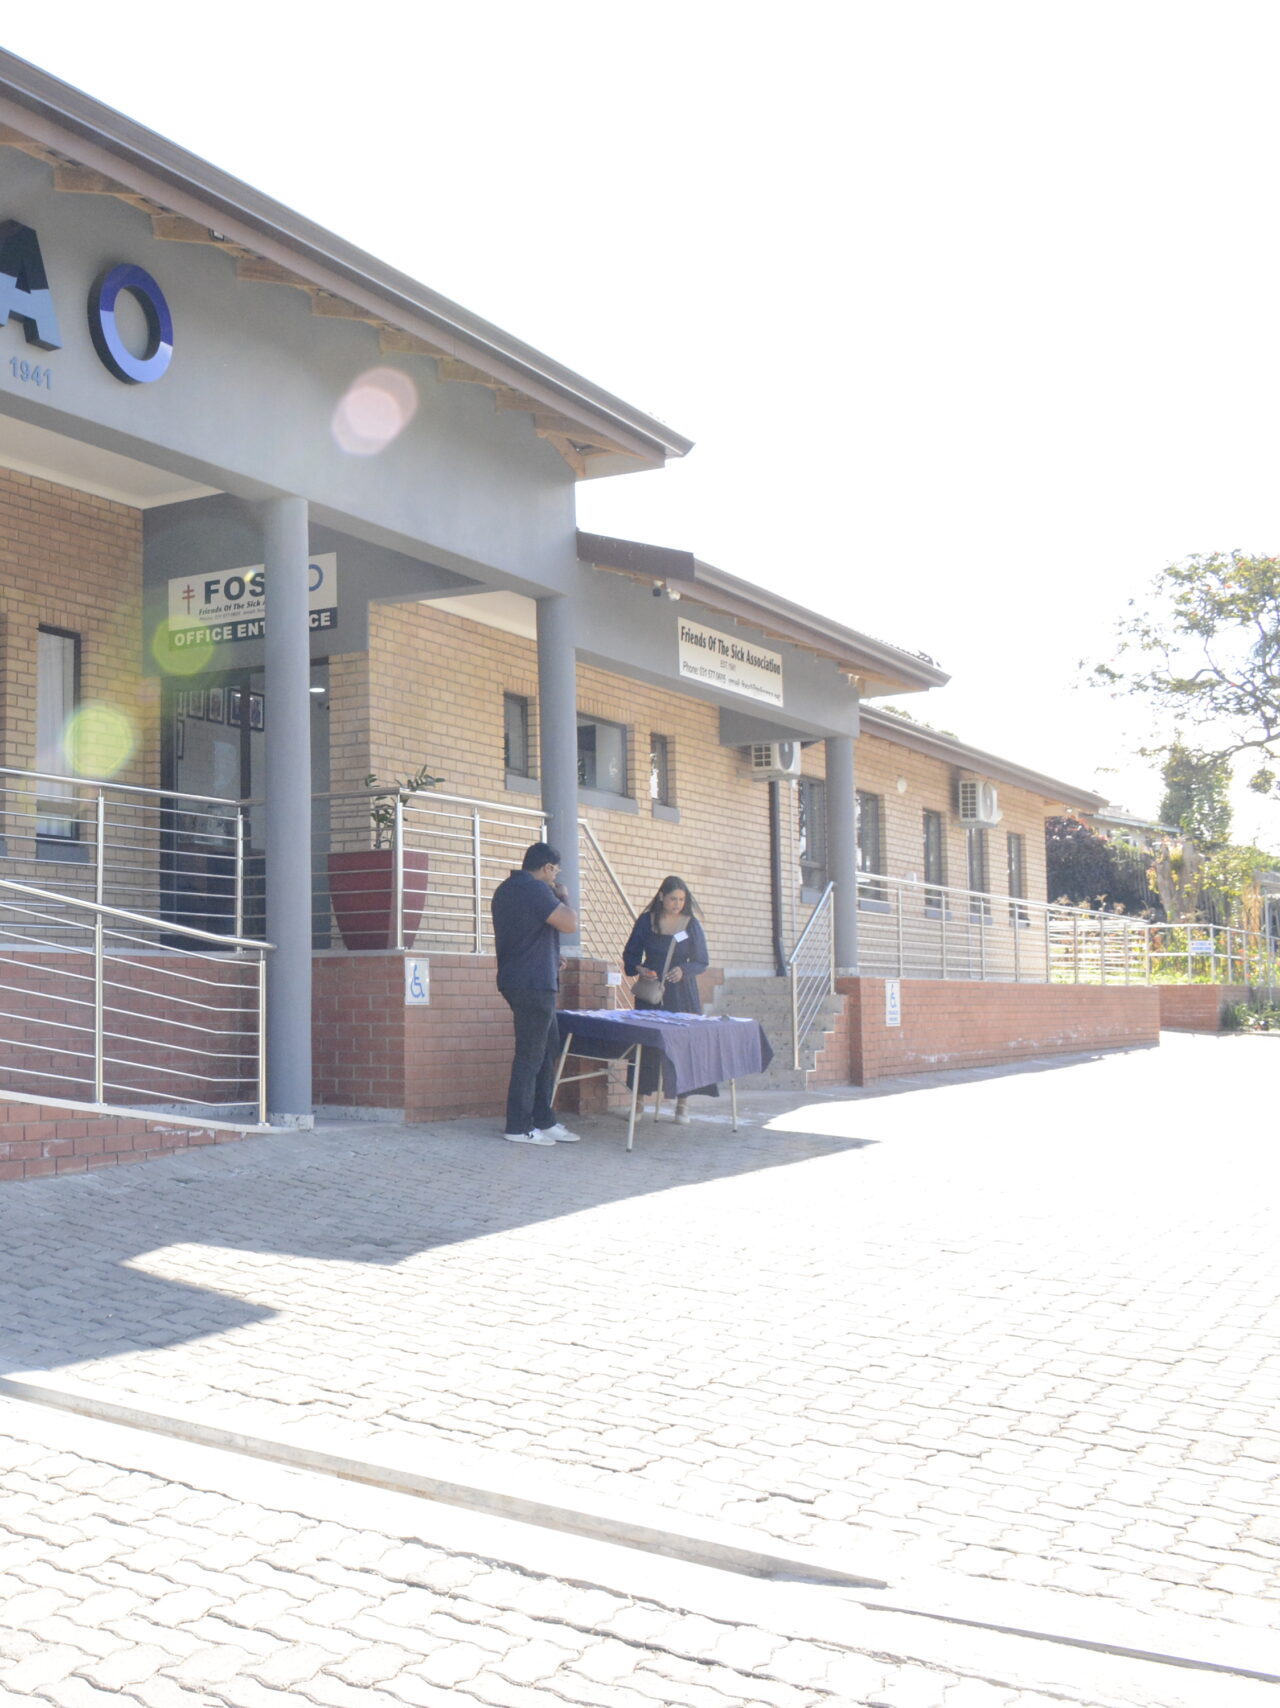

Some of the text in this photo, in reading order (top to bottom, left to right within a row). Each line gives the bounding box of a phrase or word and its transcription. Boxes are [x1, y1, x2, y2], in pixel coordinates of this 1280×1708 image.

[9, 356, 53, 390] 1941
[204, 572, 265, 604] FOS
[174, 626, 233, 646] OFFICE
[681, 626, 781, 675] Friends Of The Sick Association
